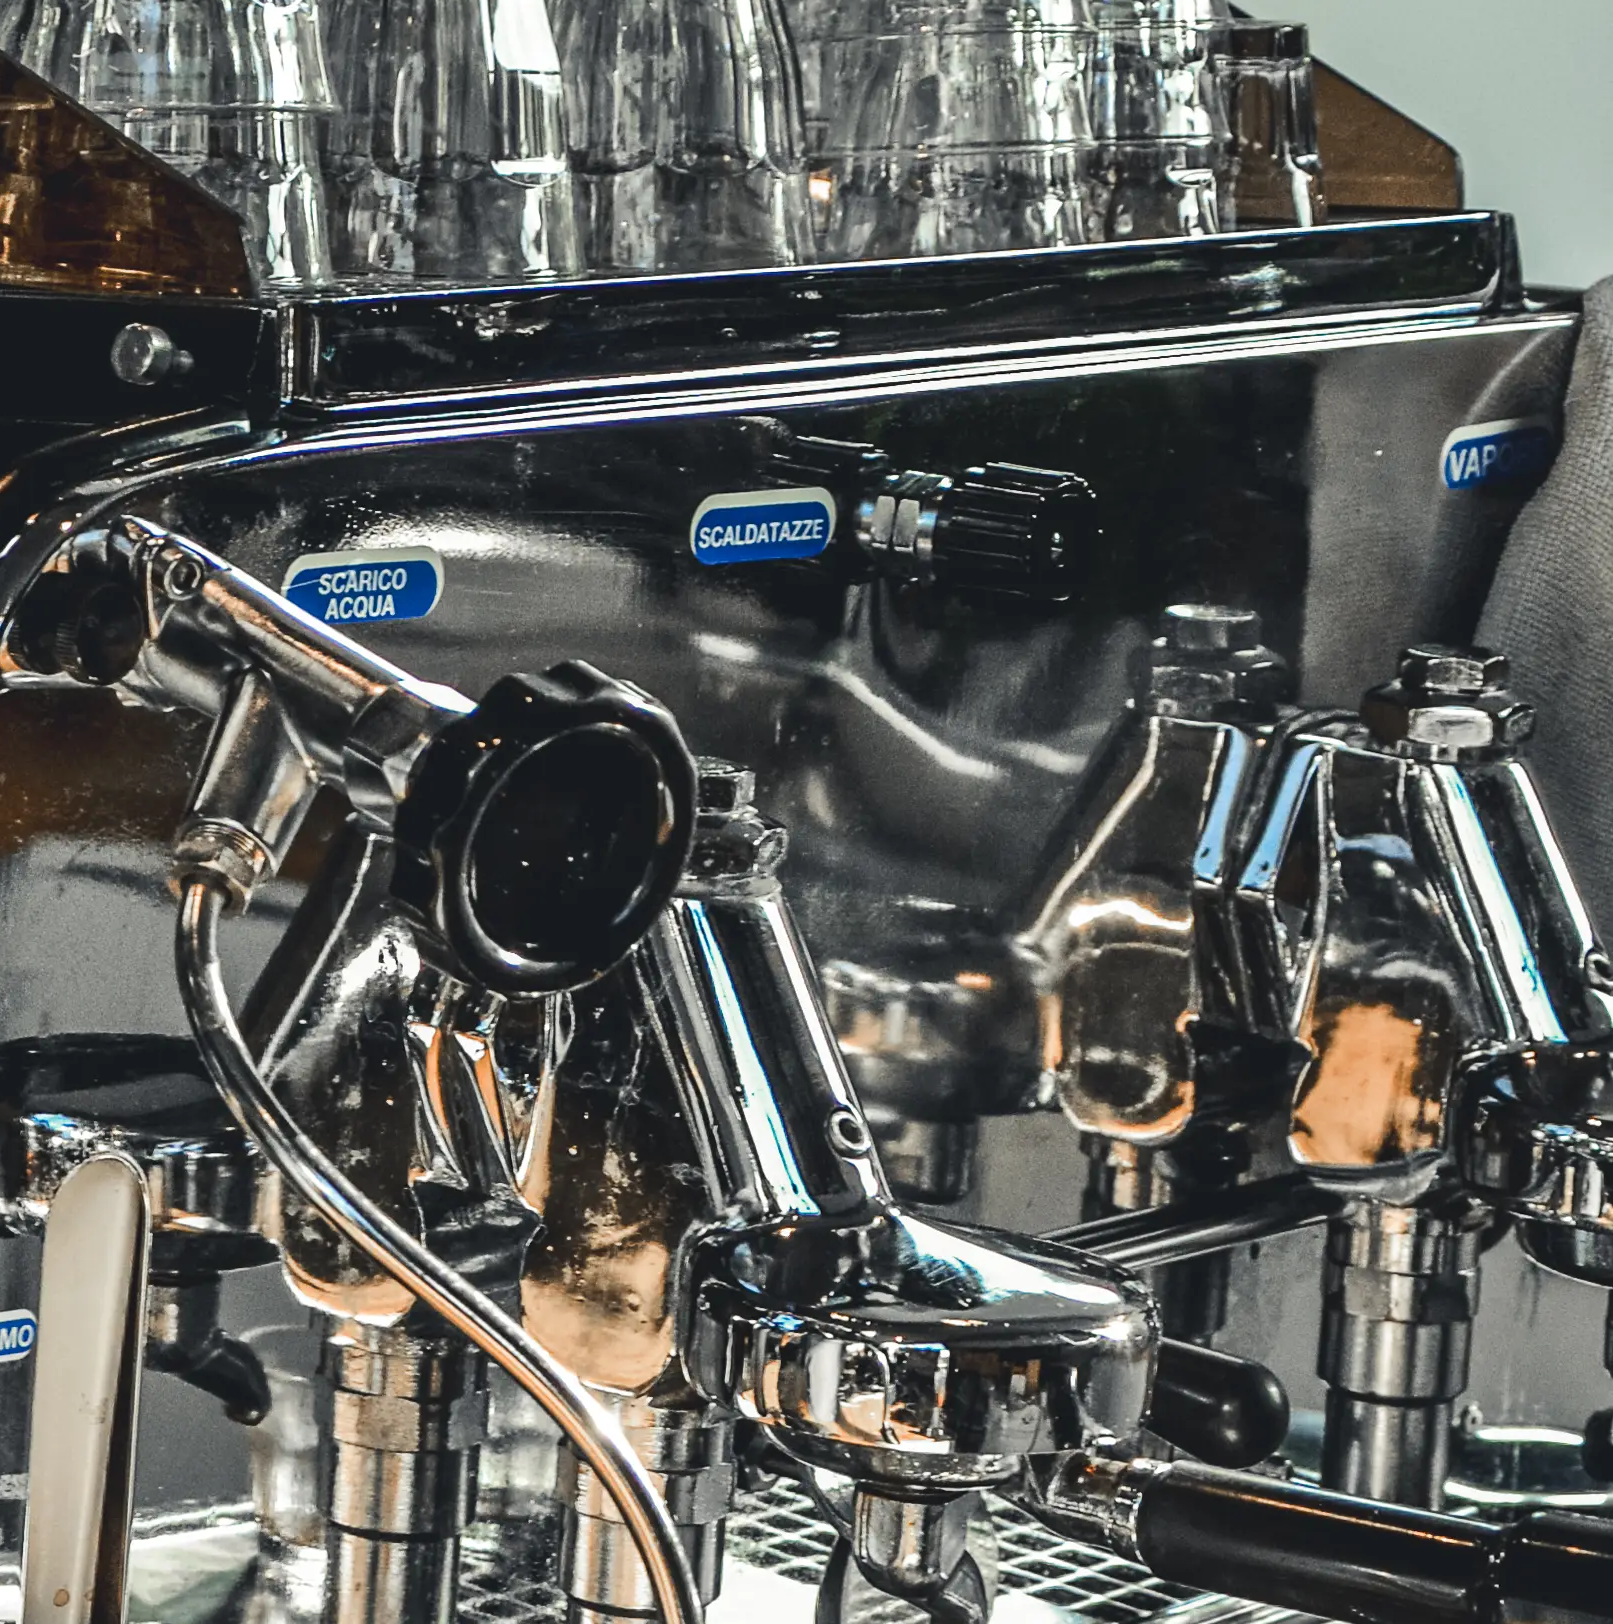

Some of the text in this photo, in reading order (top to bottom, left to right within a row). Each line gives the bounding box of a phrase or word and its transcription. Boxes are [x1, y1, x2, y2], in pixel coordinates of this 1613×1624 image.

[698, 518, 824, 548] SCALDATAZZE
[318, 568, 407, 596] SCARICO
[325, 594, 396, 619] ACQUA
